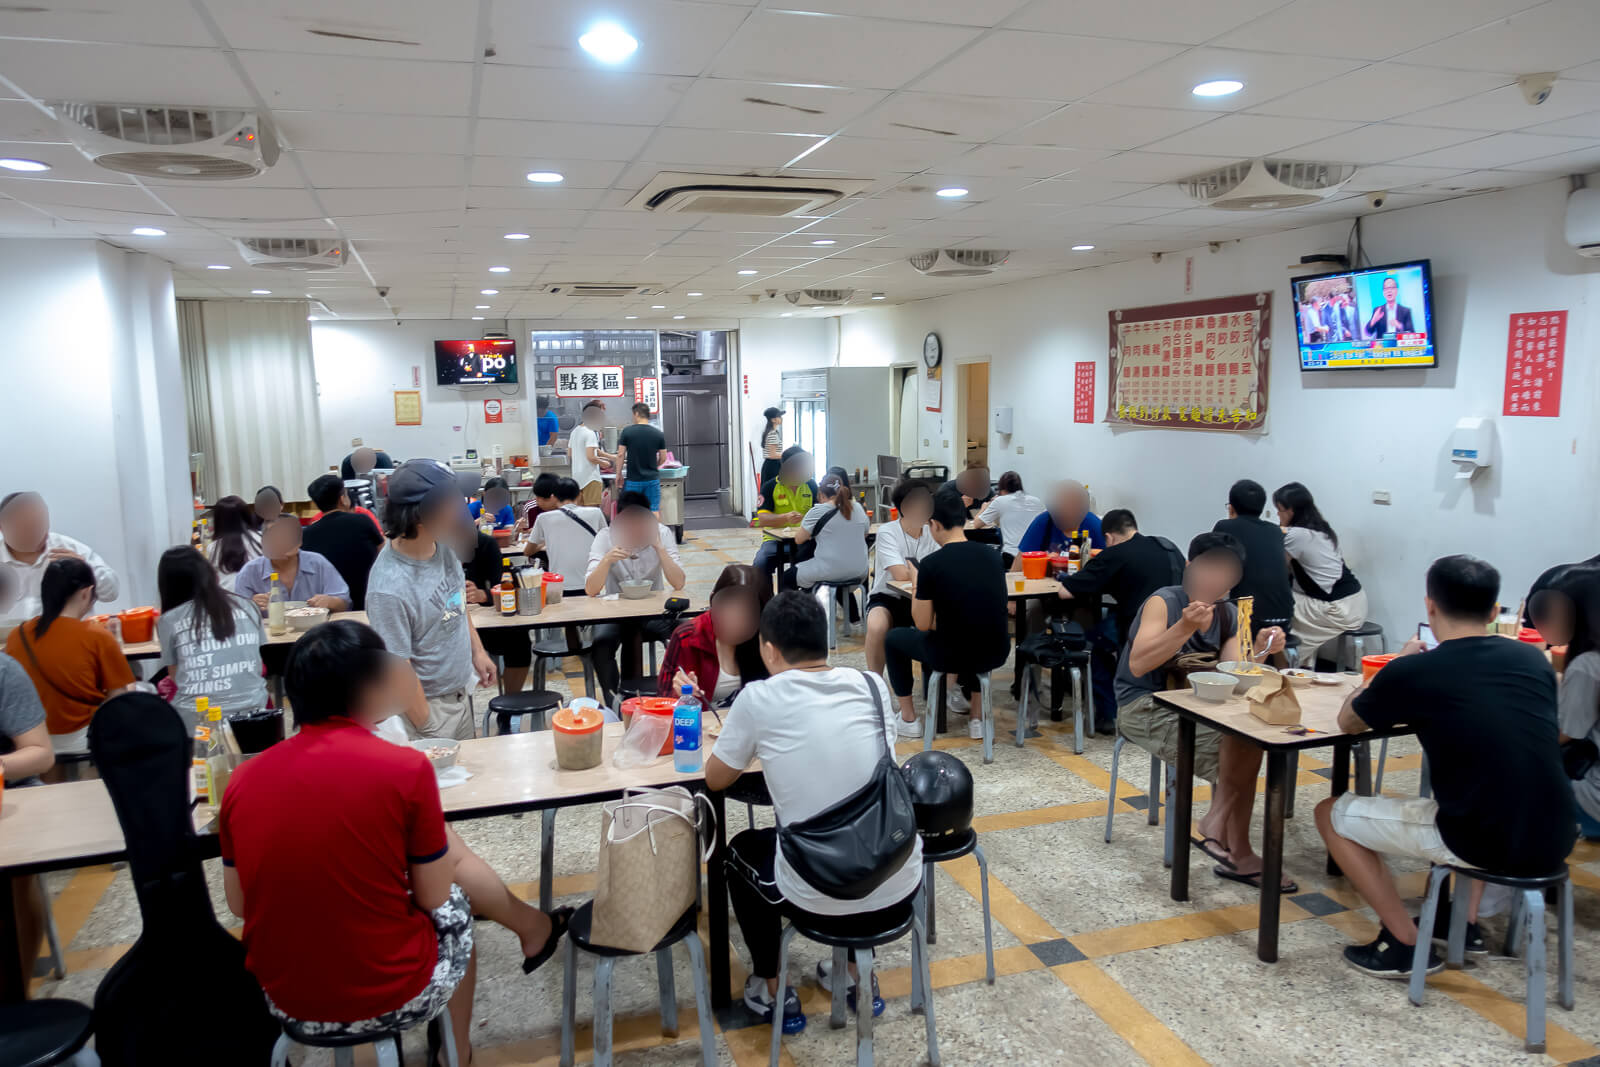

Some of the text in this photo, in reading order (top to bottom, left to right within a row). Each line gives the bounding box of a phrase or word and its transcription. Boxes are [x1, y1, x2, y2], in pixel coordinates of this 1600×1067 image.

[560, 373, 619, 391] 點餐區
[181, 643, 196, 657] OF
[674, 718, 695, 727] DEEP
